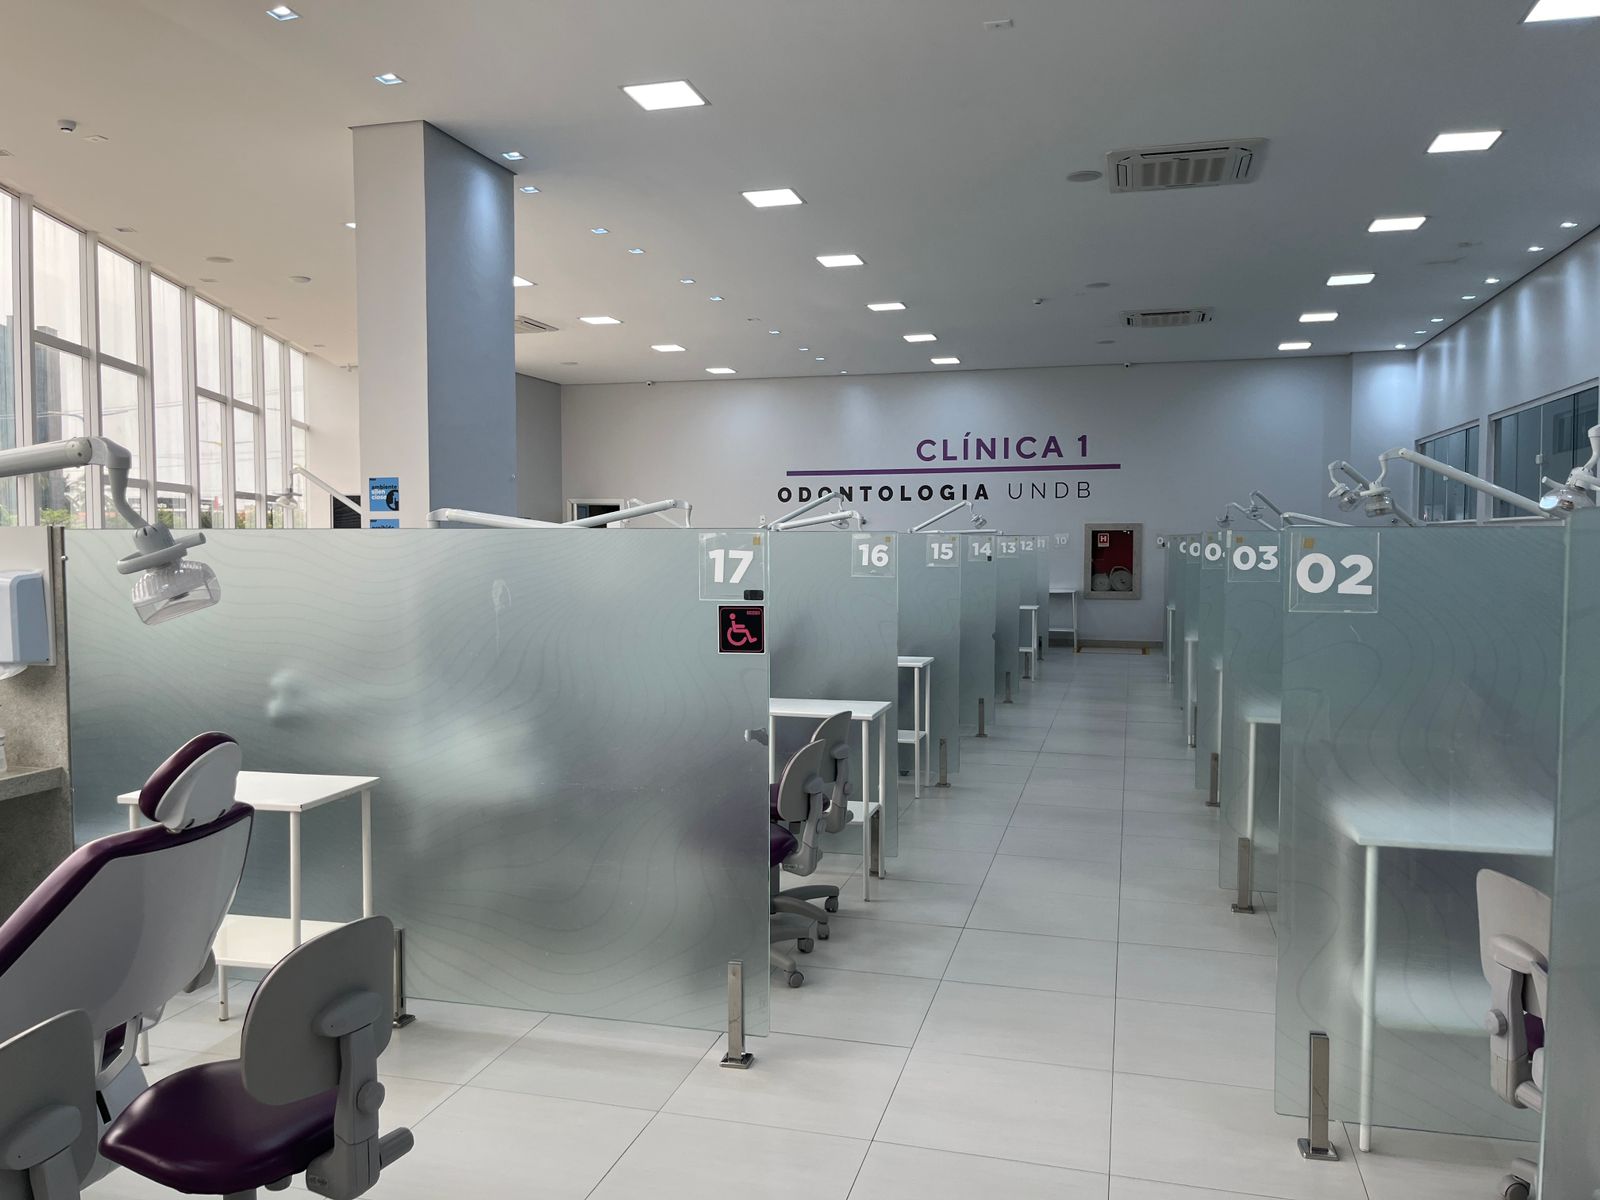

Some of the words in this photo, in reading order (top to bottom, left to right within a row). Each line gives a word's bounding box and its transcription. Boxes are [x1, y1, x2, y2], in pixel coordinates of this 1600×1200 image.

[916, 432, 1063, 462] CLÍNICA
[1077, 435, 1087, 457] 1
[777, 484, 989, 502] ODONTOLOGIA
[1008, 482, 1091, 500] UNDB
[858, 544, 889, 567] 16
[931, 543, 953, 560] 15
[972, 543, 992, 556] 14
[1001, 542, 1016, 553] 13
[1020, 541, 1033, 551] 12
[1204, 543, 1225, 561] 0
[708, 549, 754, 584] 17
[1232, 545, 1279, 571] 03
[1296, 552, 1373, 595] 02
